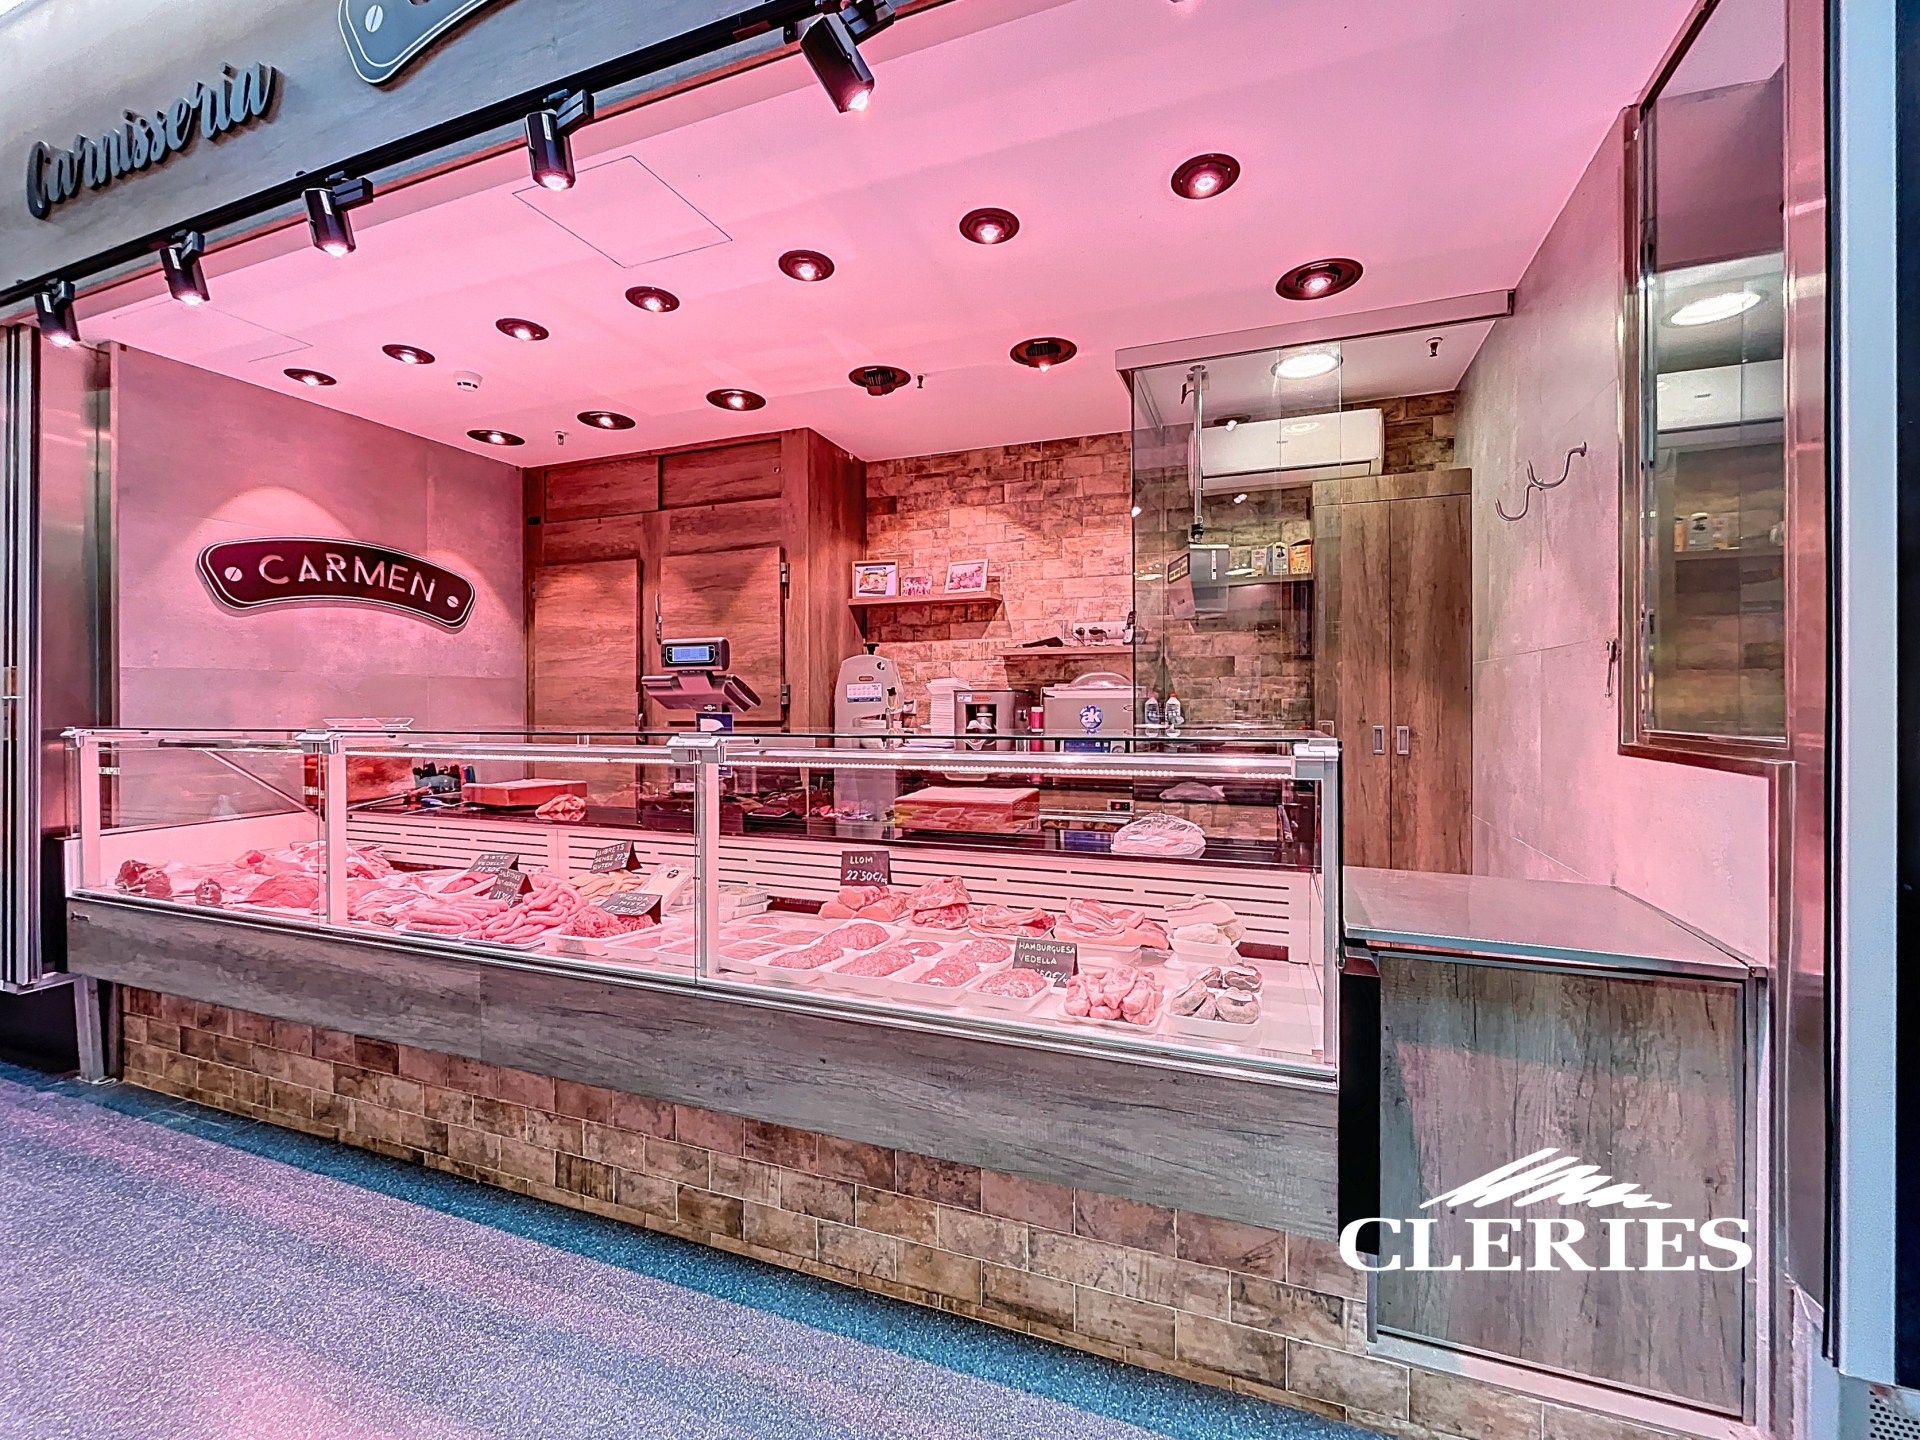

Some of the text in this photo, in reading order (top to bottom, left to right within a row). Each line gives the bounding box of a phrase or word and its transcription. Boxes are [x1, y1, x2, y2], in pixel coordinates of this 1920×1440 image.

[27, 62, 277, 219] Carnisseria
[258, 553, 436, 603] CARMEN
[849, 855, 874, 865] LLOM
[1018, 942, 1076, 955] HAMBURGUESA
[1018, 953, 1057, 965] VEDELLA
